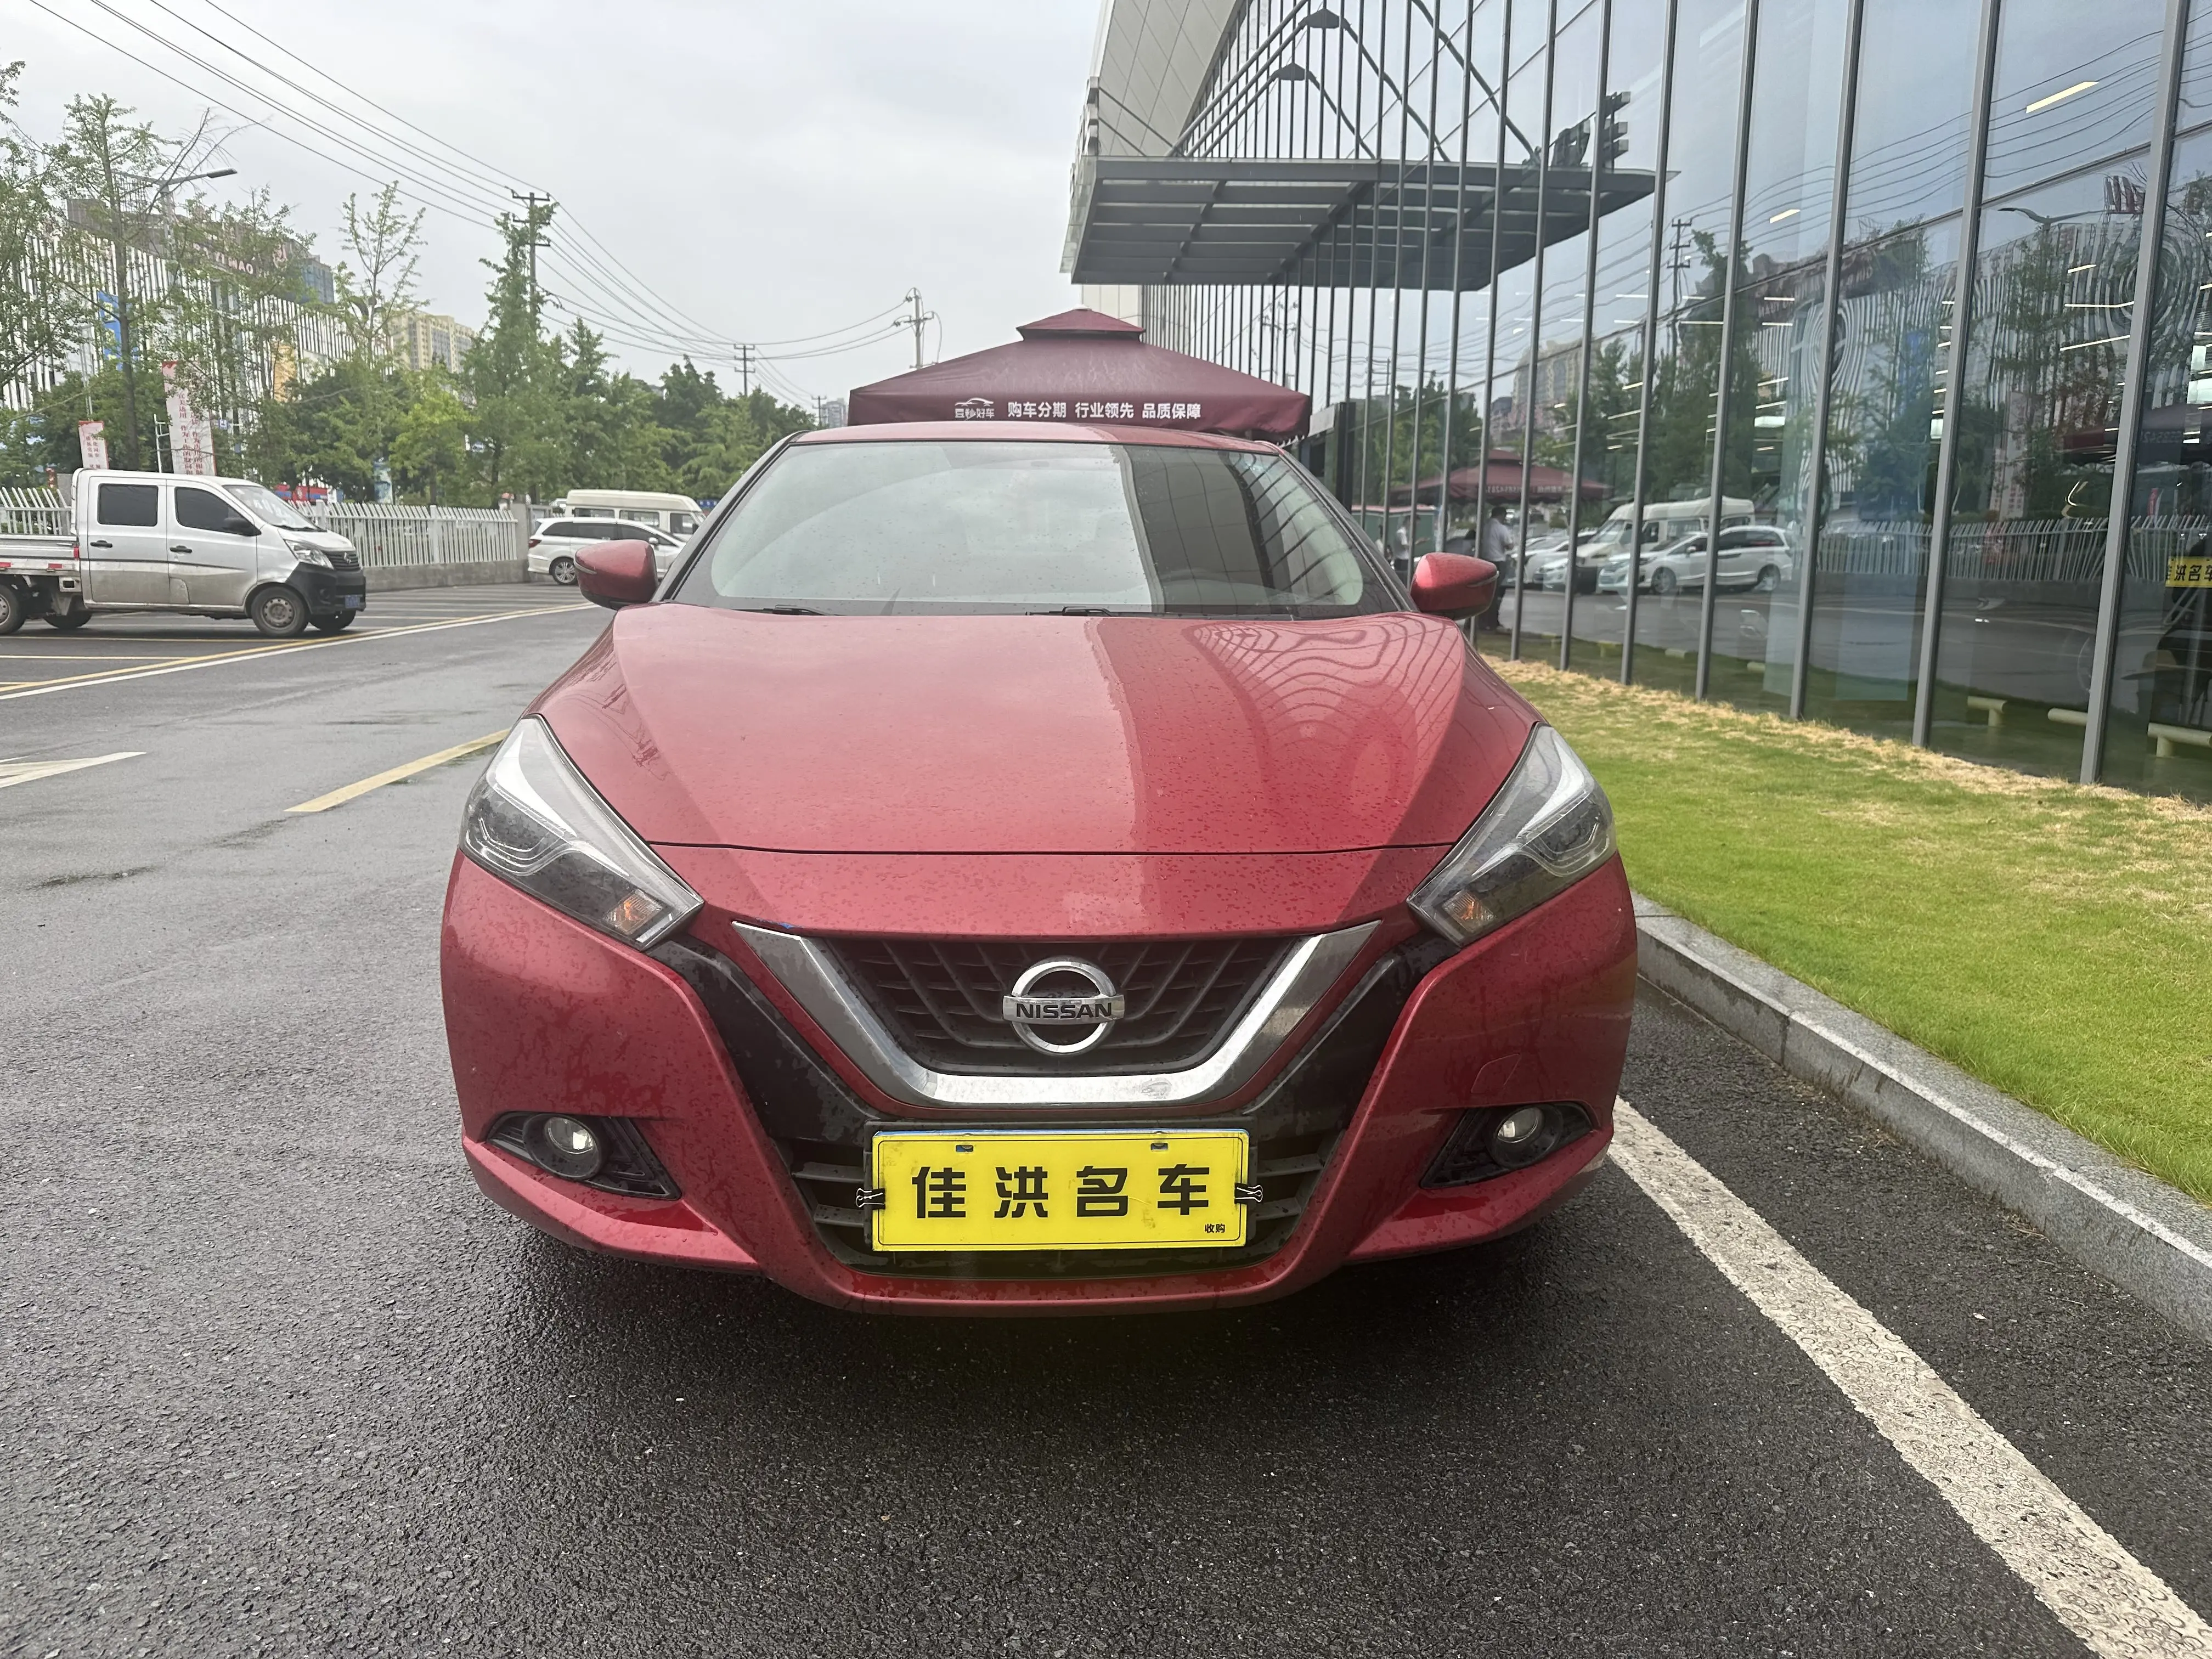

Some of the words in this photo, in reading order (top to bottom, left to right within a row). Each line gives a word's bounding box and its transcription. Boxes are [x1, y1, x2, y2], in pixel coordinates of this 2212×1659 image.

[1008, 401, 1066, 418] 购车分期
[1075, 402, 1134, 419] 行业领先
[1142, 402, 1201, 419] 品质保障
[1016, 1002, 1112, 1019] NISSAN
[911, 1163, 1210, 1219] 佳洪名车
[1204, 1223, 1226, 1233] 收购
